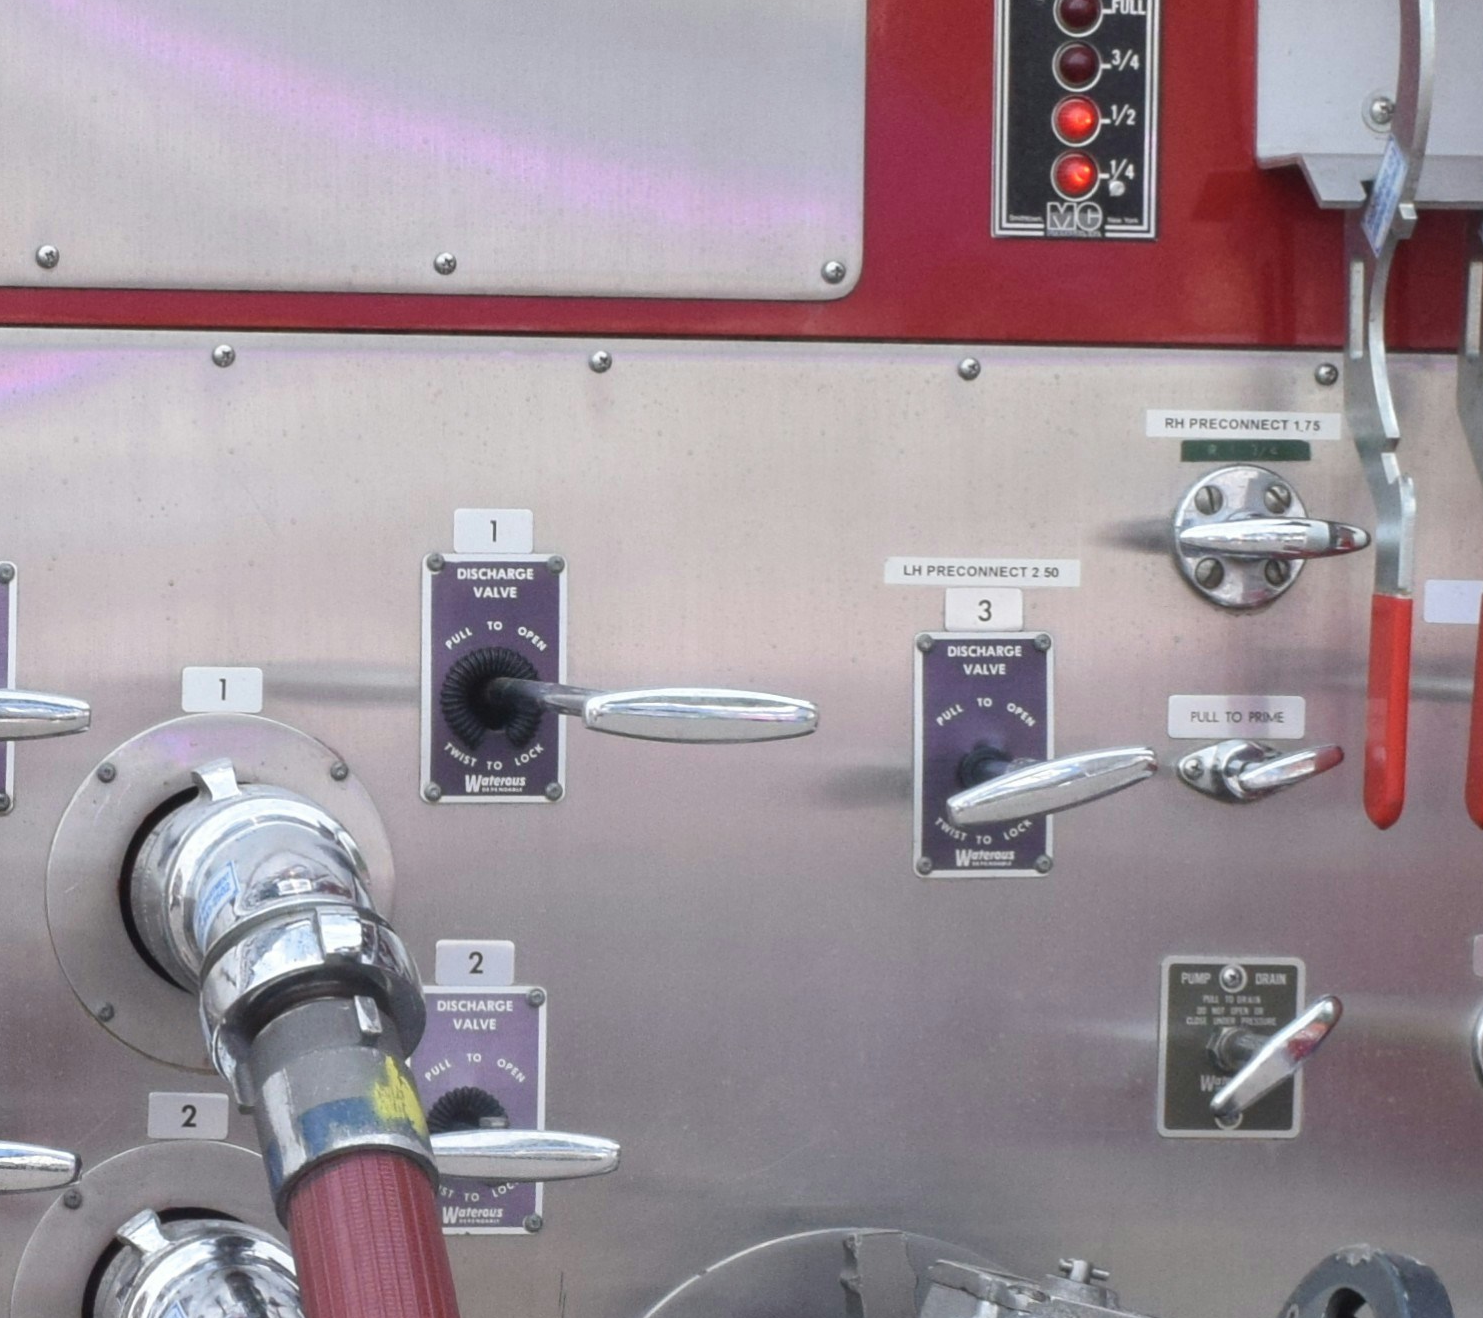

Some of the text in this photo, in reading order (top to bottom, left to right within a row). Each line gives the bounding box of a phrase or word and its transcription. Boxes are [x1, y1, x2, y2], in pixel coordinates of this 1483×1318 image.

[1111, 50, 1139, 71] 3/4
[1111, 105, 1136, 125] 1/2
[1110, 159, 1134, 180] 1/4
[1164, 418, 1186, 431] RH
[1189, 418, 1289, 432] PRECONNECT
[490, 520, 497, 542] 1
[457, 568, 534, 580] DISCHARGE
[903, 565, 922, 576] LH
[926, 565, 1027, 578] PRECONNECT
[473, 587, 517, 599] VALVE
[978, 599, 992, 622] 3
[445, 621, 547, 652] PULL TO OPEN
[948, 645, 1022, 657] DISCHARGE
[963, 664, 1006, 675] VALVE
[219, 679, 228, 701] 1
[1191, 711, 1285, 724] PULL TO PRIME
[469, 952, 483, 974] 2
[1181, 972, 1286, 985] PUMP DRAIN
[437, 1000, 513, 1012] DISCHARGE
[453, 1018, 497, 1030] VALVE
[182, 1105, 197, 1127] 2
